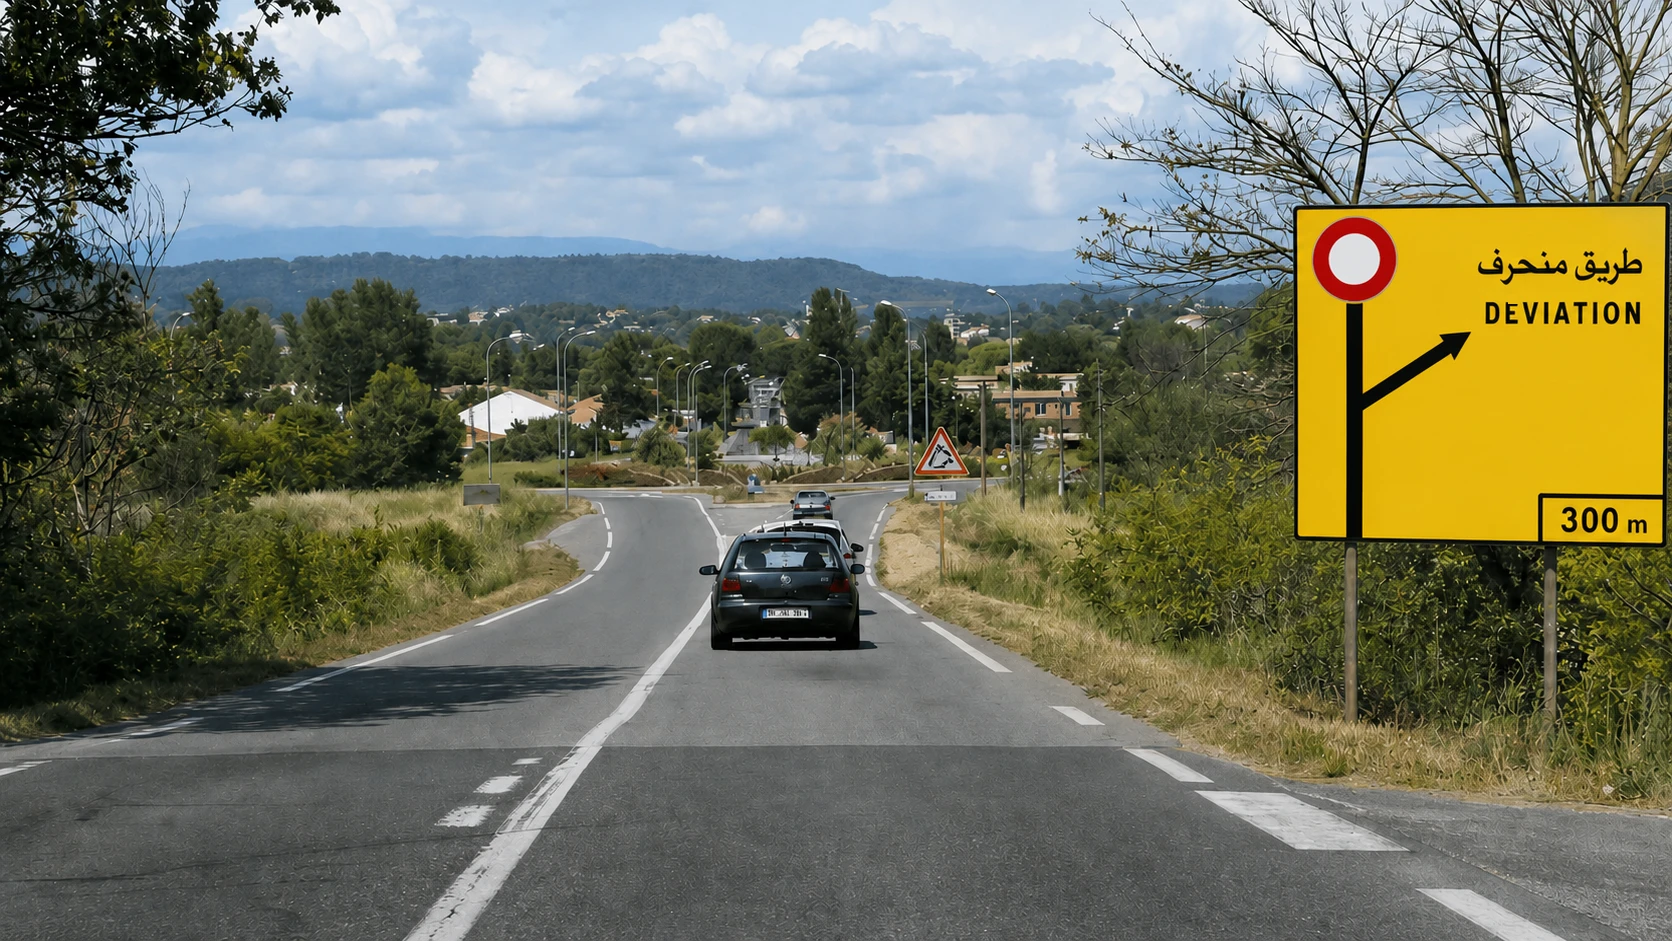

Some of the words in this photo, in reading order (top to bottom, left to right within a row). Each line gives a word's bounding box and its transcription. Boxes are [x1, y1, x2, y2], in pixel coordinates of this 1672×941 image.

[1478, 249, 1568, 285] منحرف
[1575, 248, 1643, 285] طريق
[1485, 301, 1641, 325] DEVIATION
[1561, 507, 1619, 533] 300
[1627, 519, 1648, 534] m
